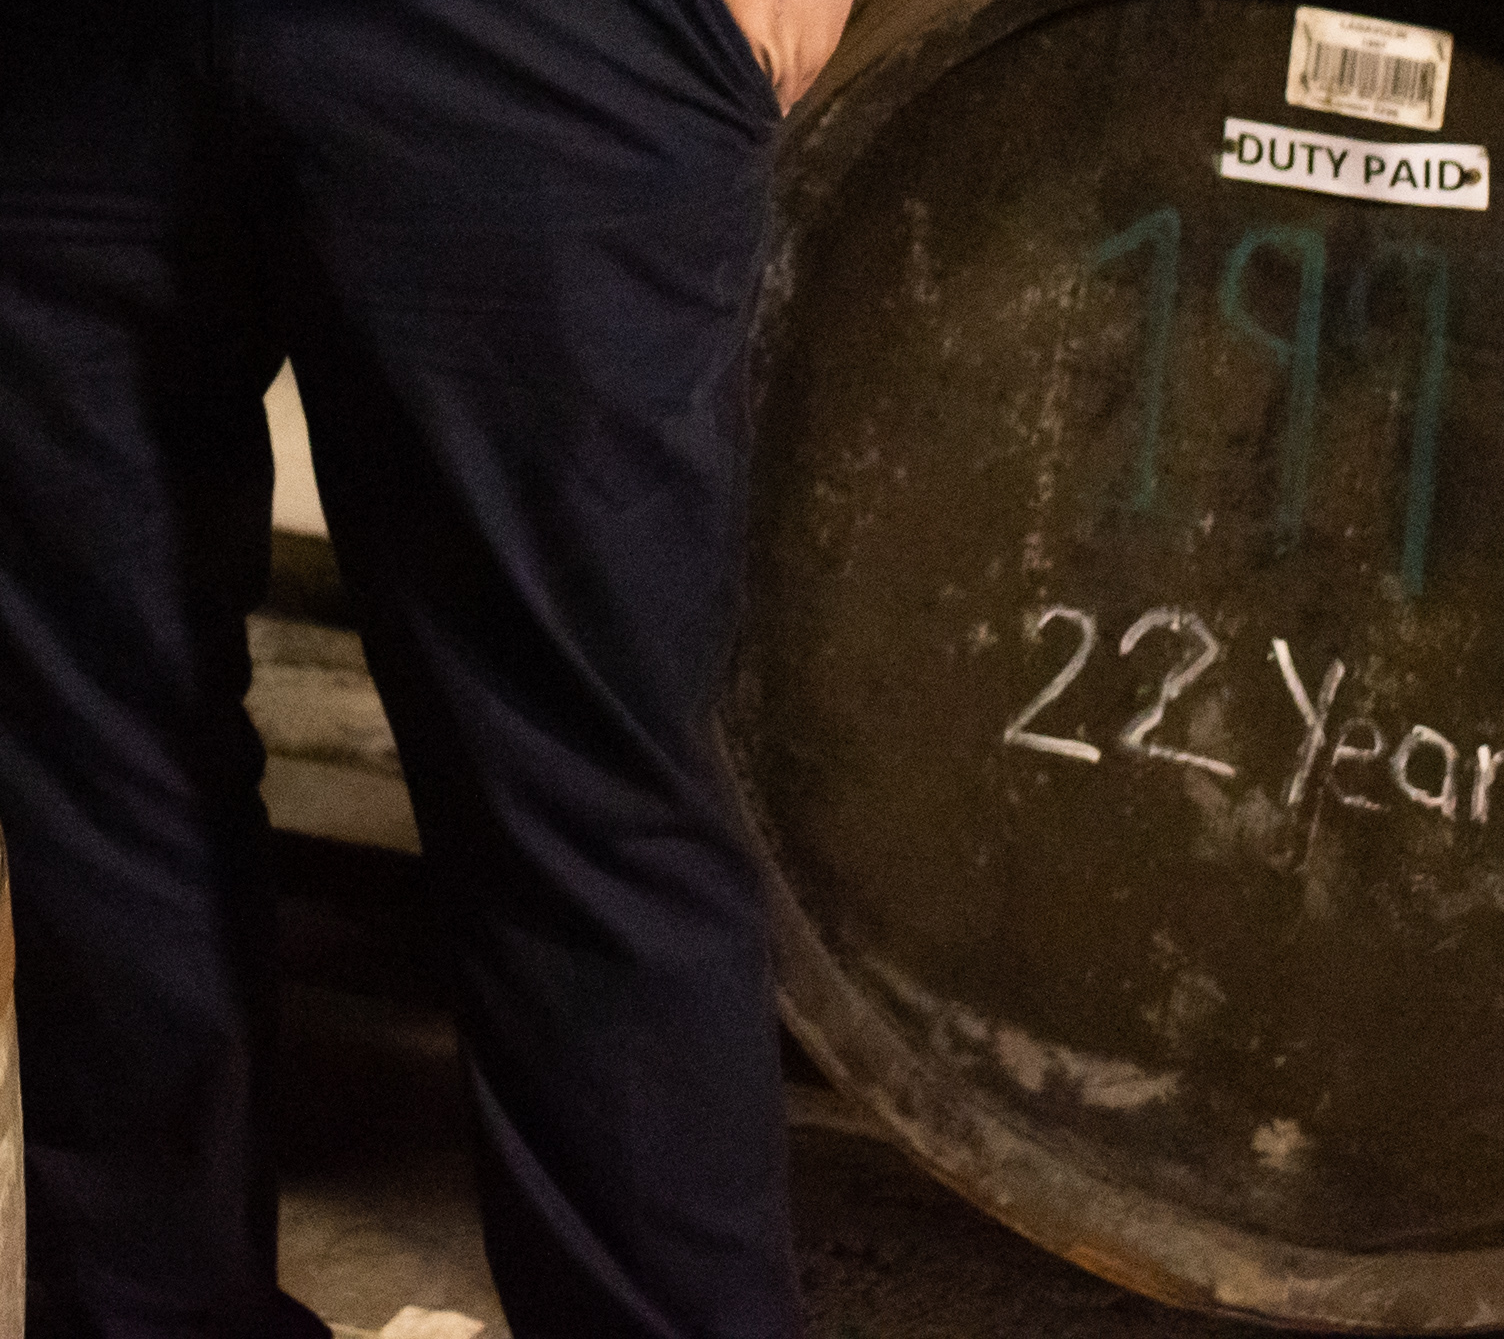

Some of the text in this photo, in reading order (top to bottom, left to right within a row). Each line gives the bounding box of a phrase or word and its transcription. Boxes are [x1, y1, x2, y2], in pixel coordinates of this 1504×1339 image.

[1237, 132, 1465, 191] DUTY PAID
[1003, 604, 1238, 779] 22
